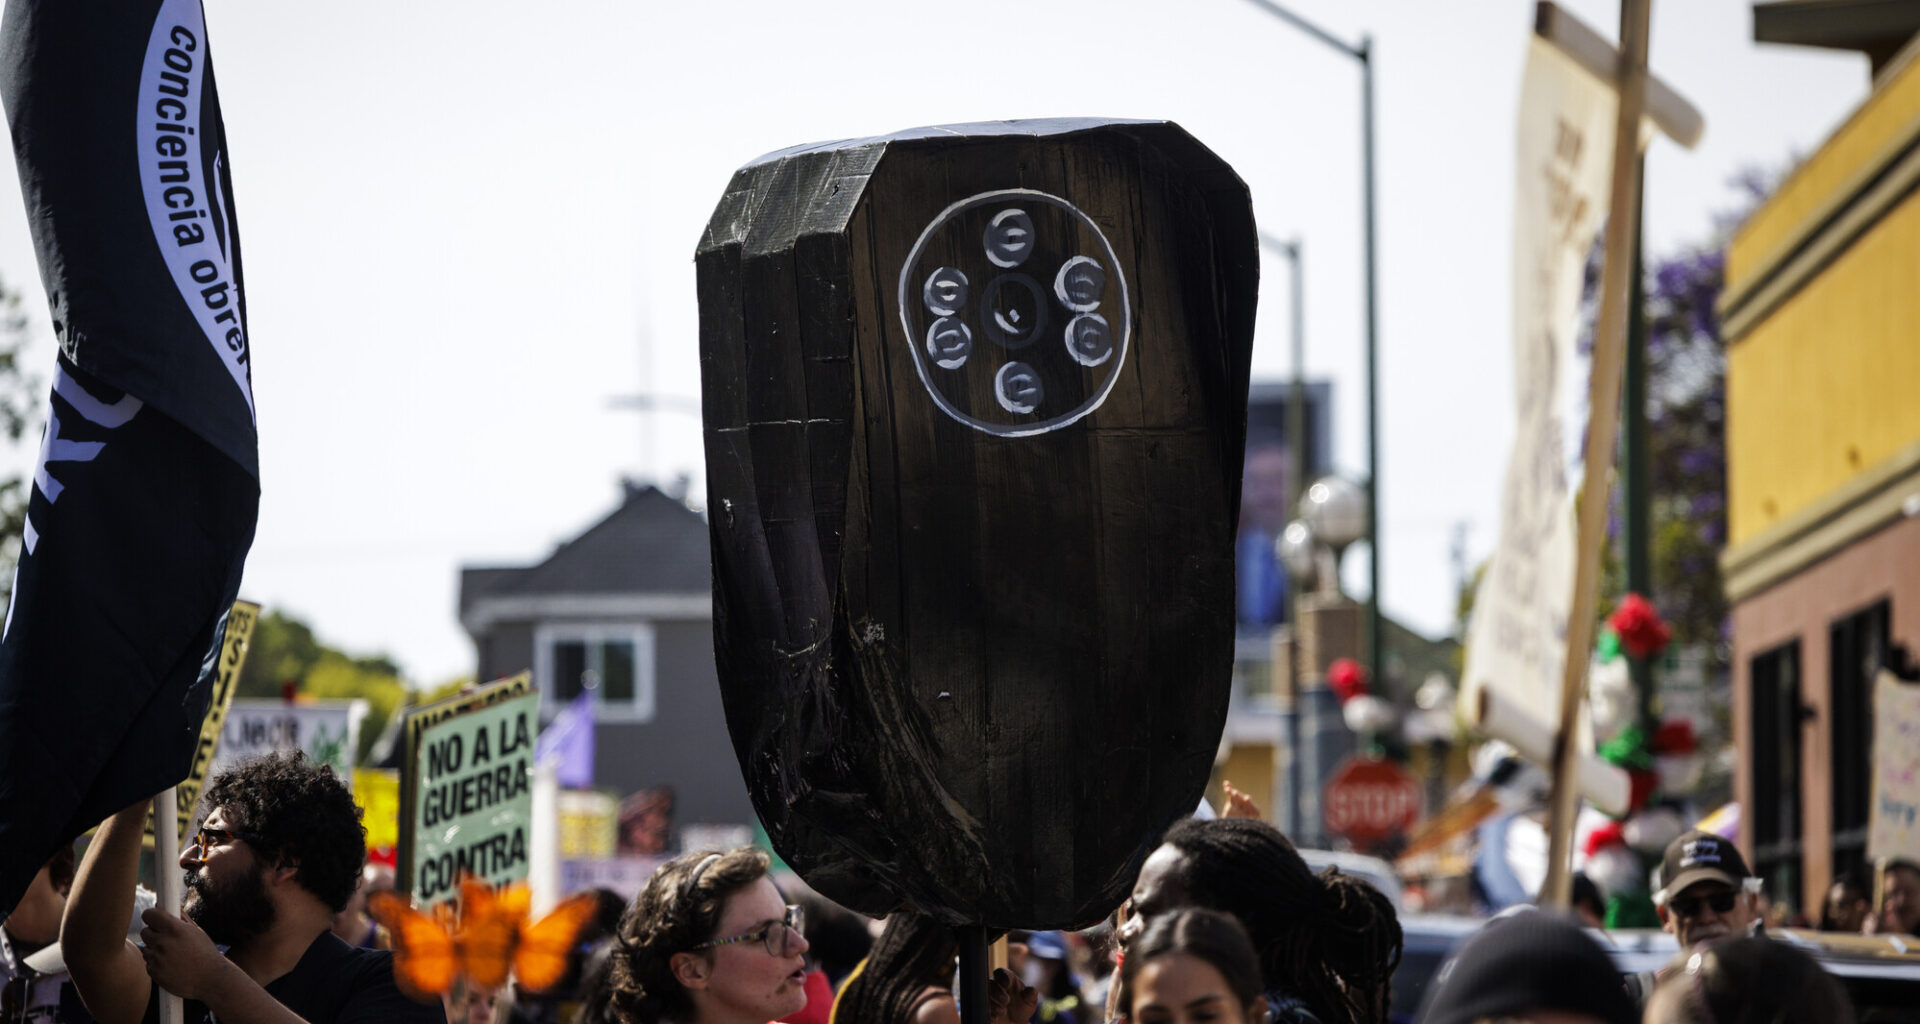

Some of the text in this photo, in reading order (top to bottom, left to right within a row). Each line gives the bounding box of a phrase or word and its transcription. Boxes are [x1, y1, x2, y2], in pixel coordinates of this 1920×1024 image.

[156, 25, 206, 247] conciencia
[428, 712, 530, 782] NO A LA
[424, 758, 528, 829] GUERRA
[1330, 786, 1413, 824] STOP
[420, 826, 526, 899] CONTRA
